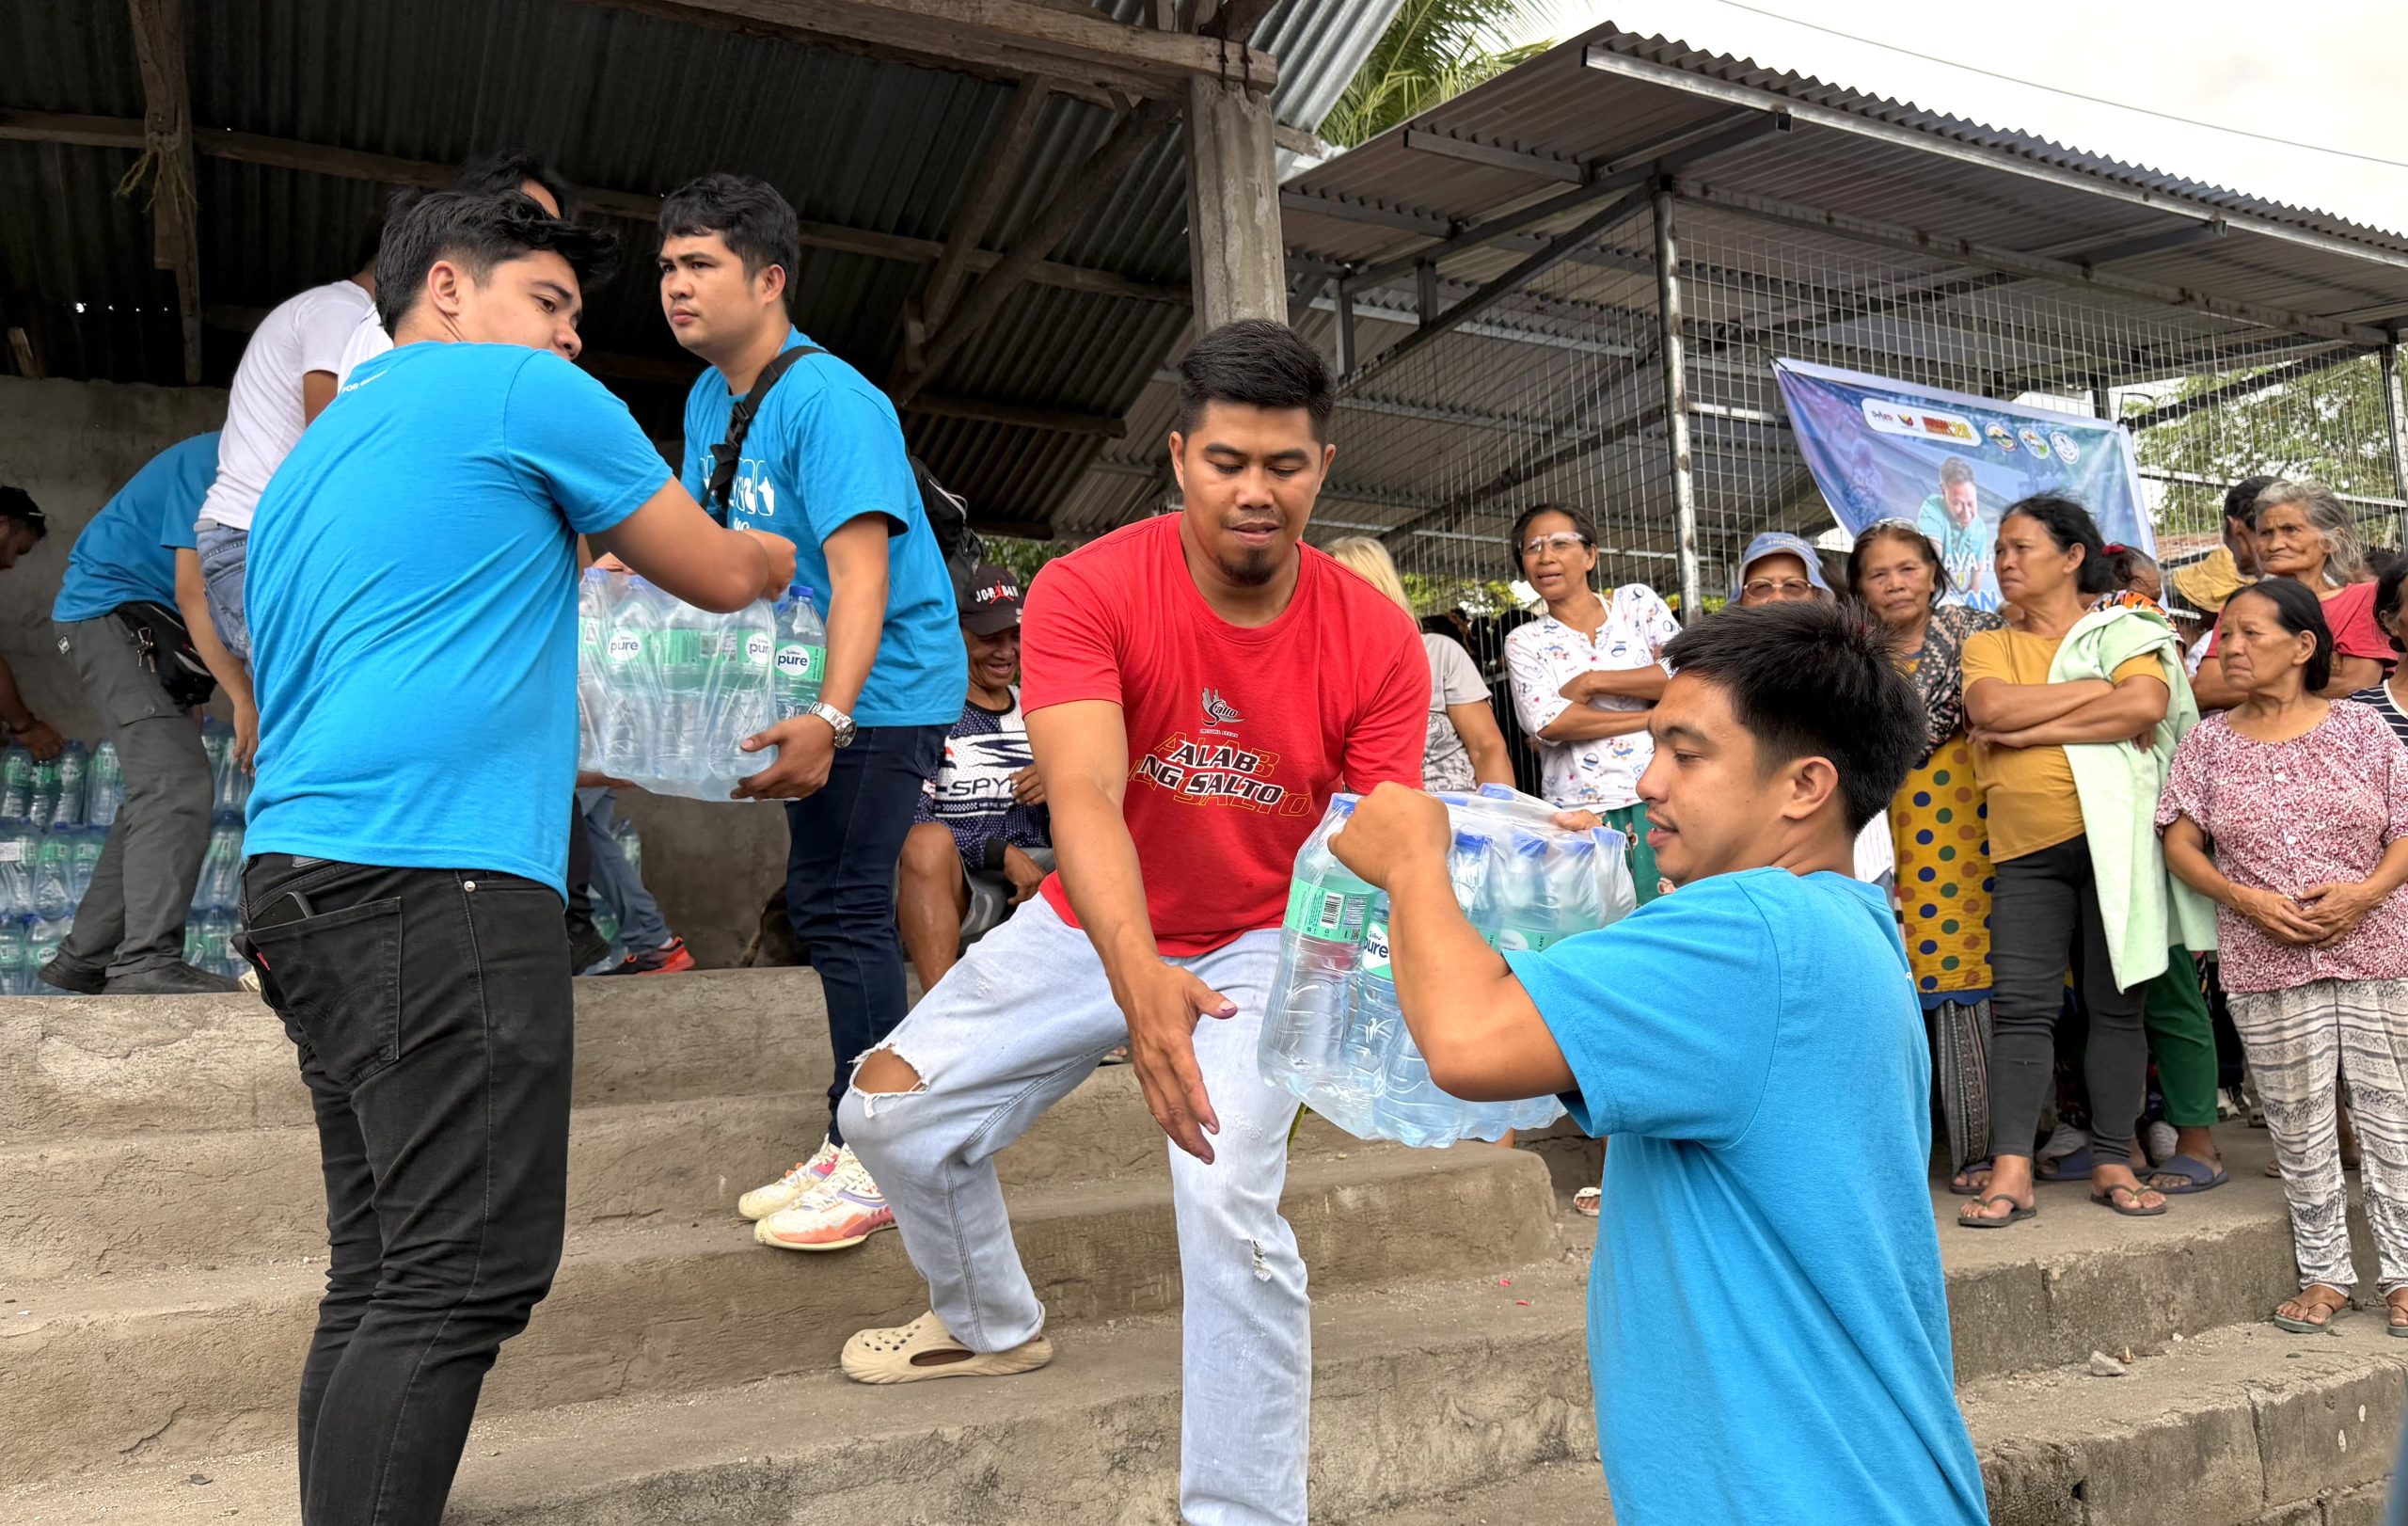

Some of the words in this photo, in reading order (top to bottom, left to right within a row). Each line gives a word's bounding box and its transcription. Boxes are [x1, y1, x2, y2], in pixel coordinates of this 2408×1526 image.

[610, 641, 639, 654] pure
[749, 643, 769, 655] pur
[777, 655, 808, 666] pure
[1202, 699, 1238, 726] Salto
[1167, 741, 1259, 773] ALAB
[948, 777, 1014, 797] SPY
[1139, 755, 1183, 787] NG
[1185, 771, 1285, 804] SALTO
